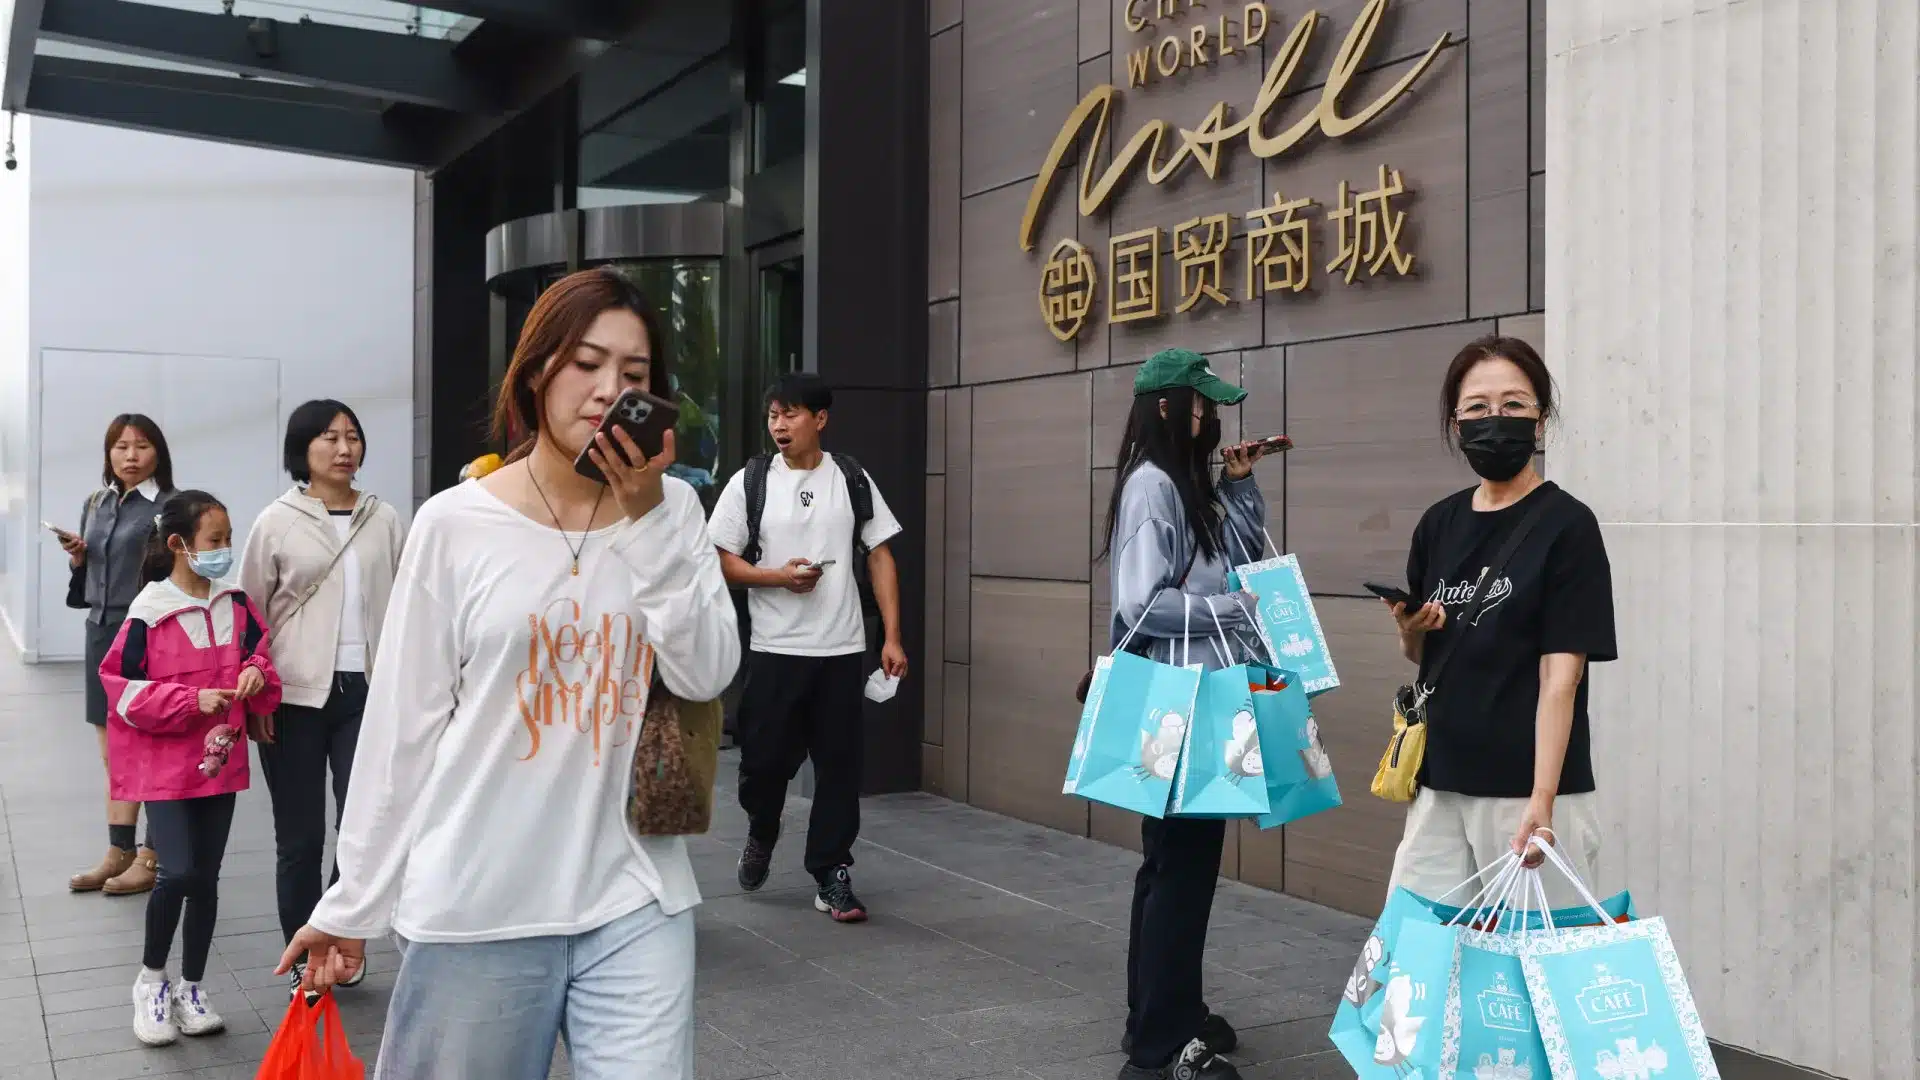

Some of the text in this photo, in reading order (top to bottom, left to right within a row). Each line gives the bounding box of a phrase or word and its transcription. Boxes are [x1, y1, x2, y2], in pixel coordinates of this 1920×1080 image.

[1127, 2, 1267, 88] WORLD
[1109, 164, 1415, 324] 国贸商城
[800, 491, 814, 500] CN
[801, 499, 811, 508] W
[516, 667, 640, 766] Simpe
[1488, 1002, 1525, 1021] CAFÉ
[1591, 989, 1636, 1012] CAFÉ
